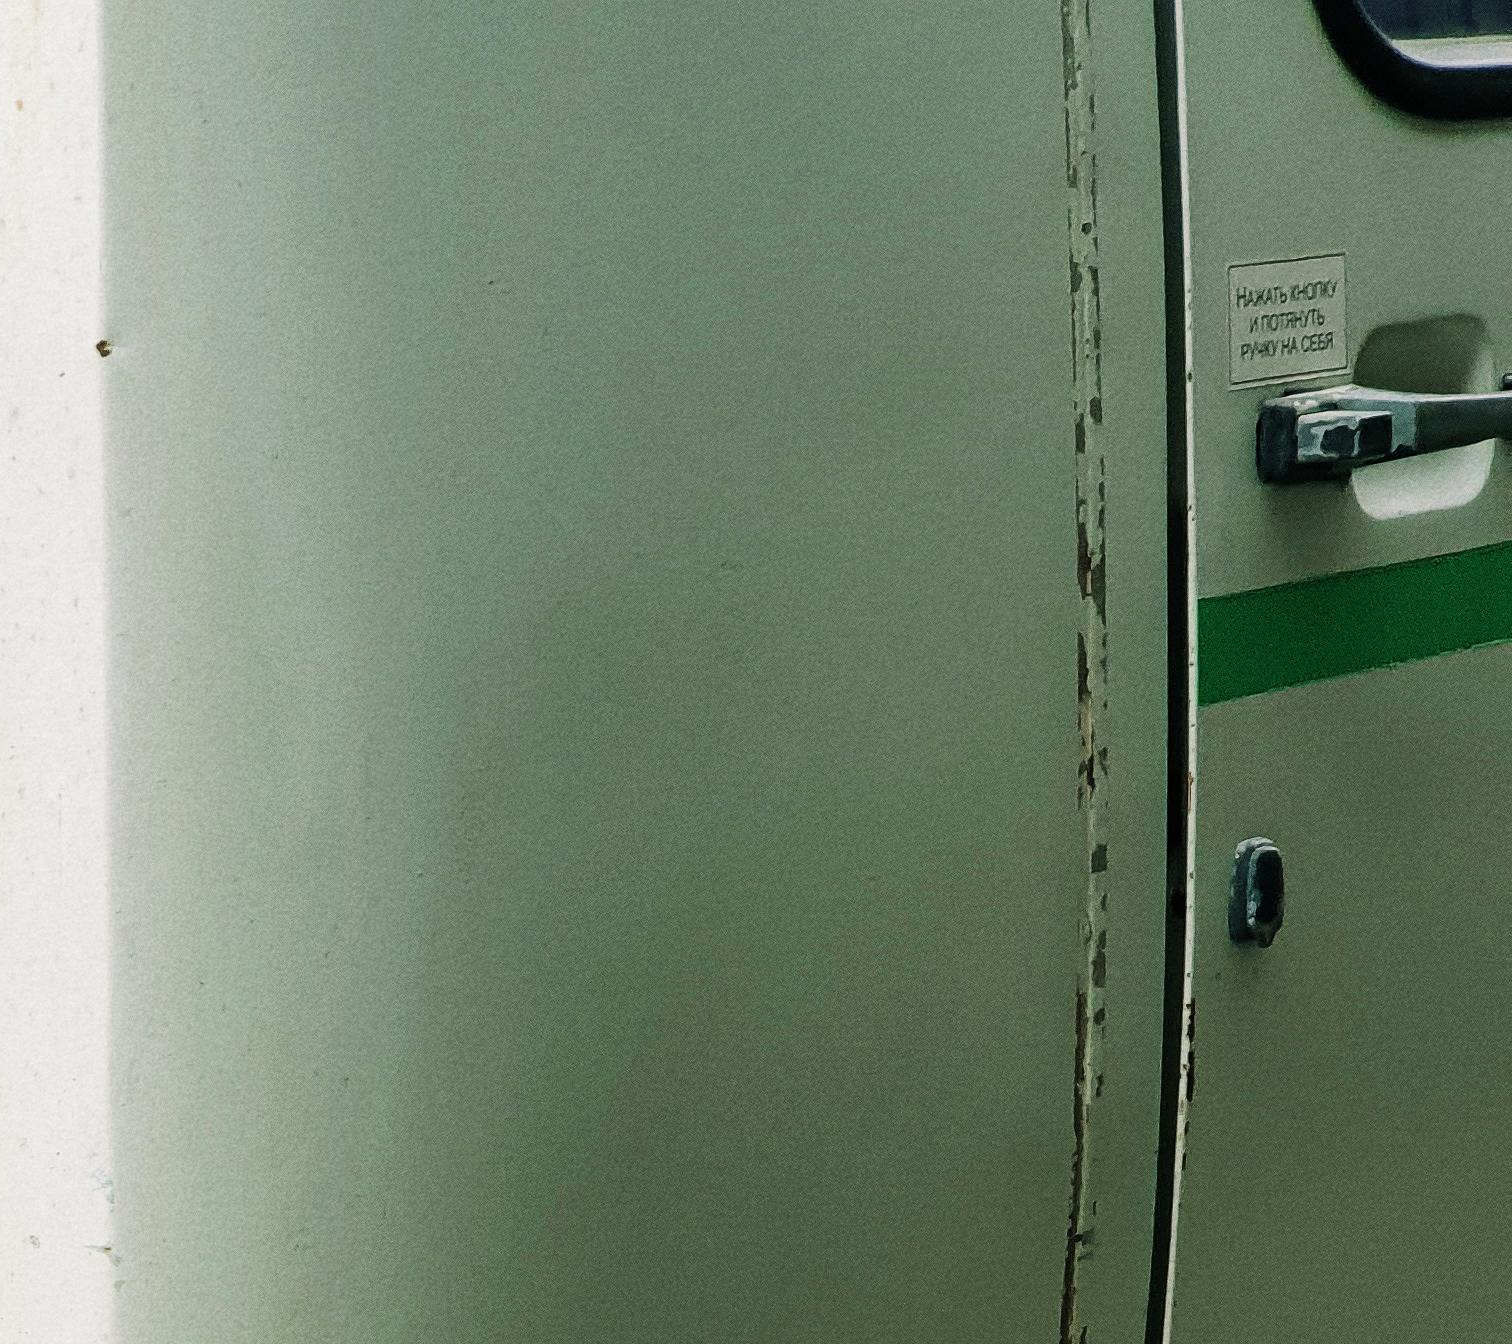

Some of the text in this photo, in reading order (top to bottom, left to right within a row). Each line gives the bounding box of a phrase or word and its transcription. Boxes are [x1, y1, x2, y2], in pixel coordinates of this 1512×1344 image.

[1236, 279, 1338, 309] НАЖАТЬ КНОПКУ
[1248, 307, 1326, 334] И ПОТЯНУТЬ
[1240, 331, 1335, 361] РУЧКУ НА СЕБЯ
